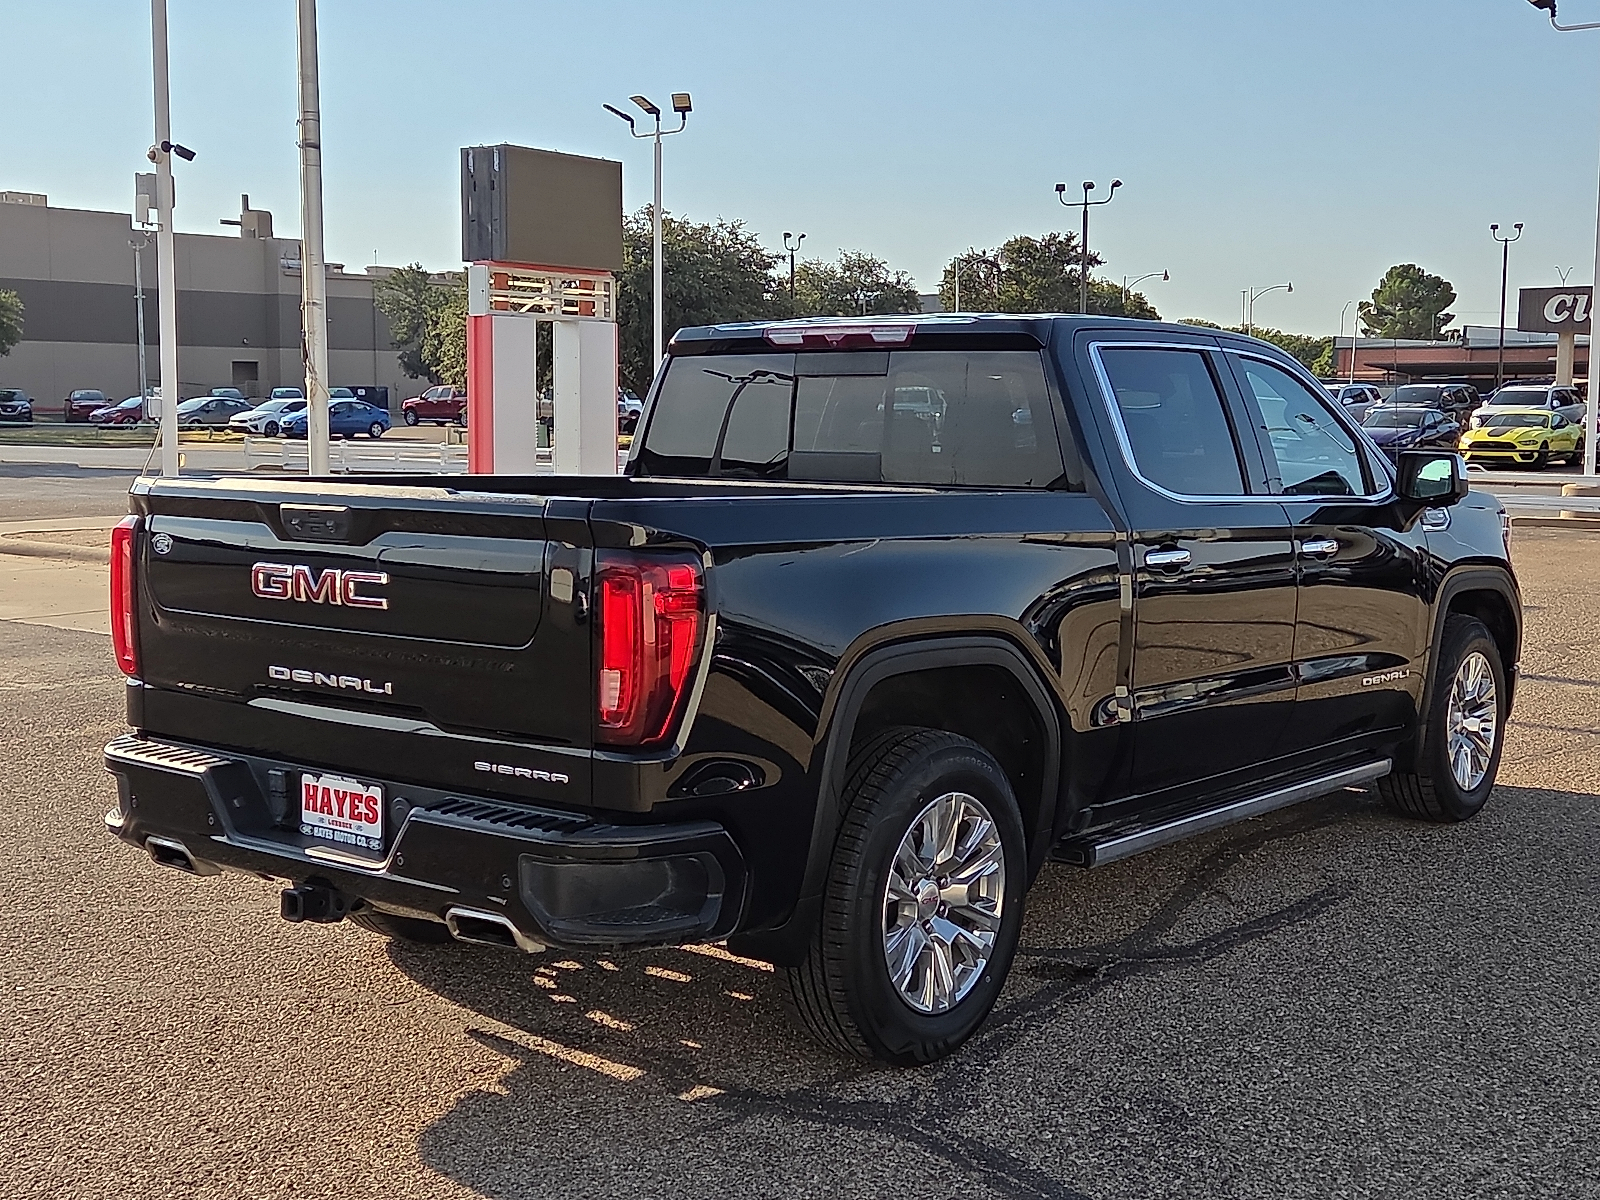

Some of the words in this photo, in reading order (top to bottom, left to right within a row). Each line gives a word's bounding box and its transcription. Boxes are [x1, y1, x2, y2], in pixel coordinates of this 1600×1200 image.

[1543, 293, 1592, 323] Cl
[251, 561, 389, 610] GMC
[268, 665, 393, 695] DENALI
[1362, 669, 1410, 686] DENALI
[474, 761, 569, 784] SIERRA
[304, 783, 378, 824] HAYES
[314, 827, 333, 839] HAYES
[334, 830, 356, 844] MOTOR
